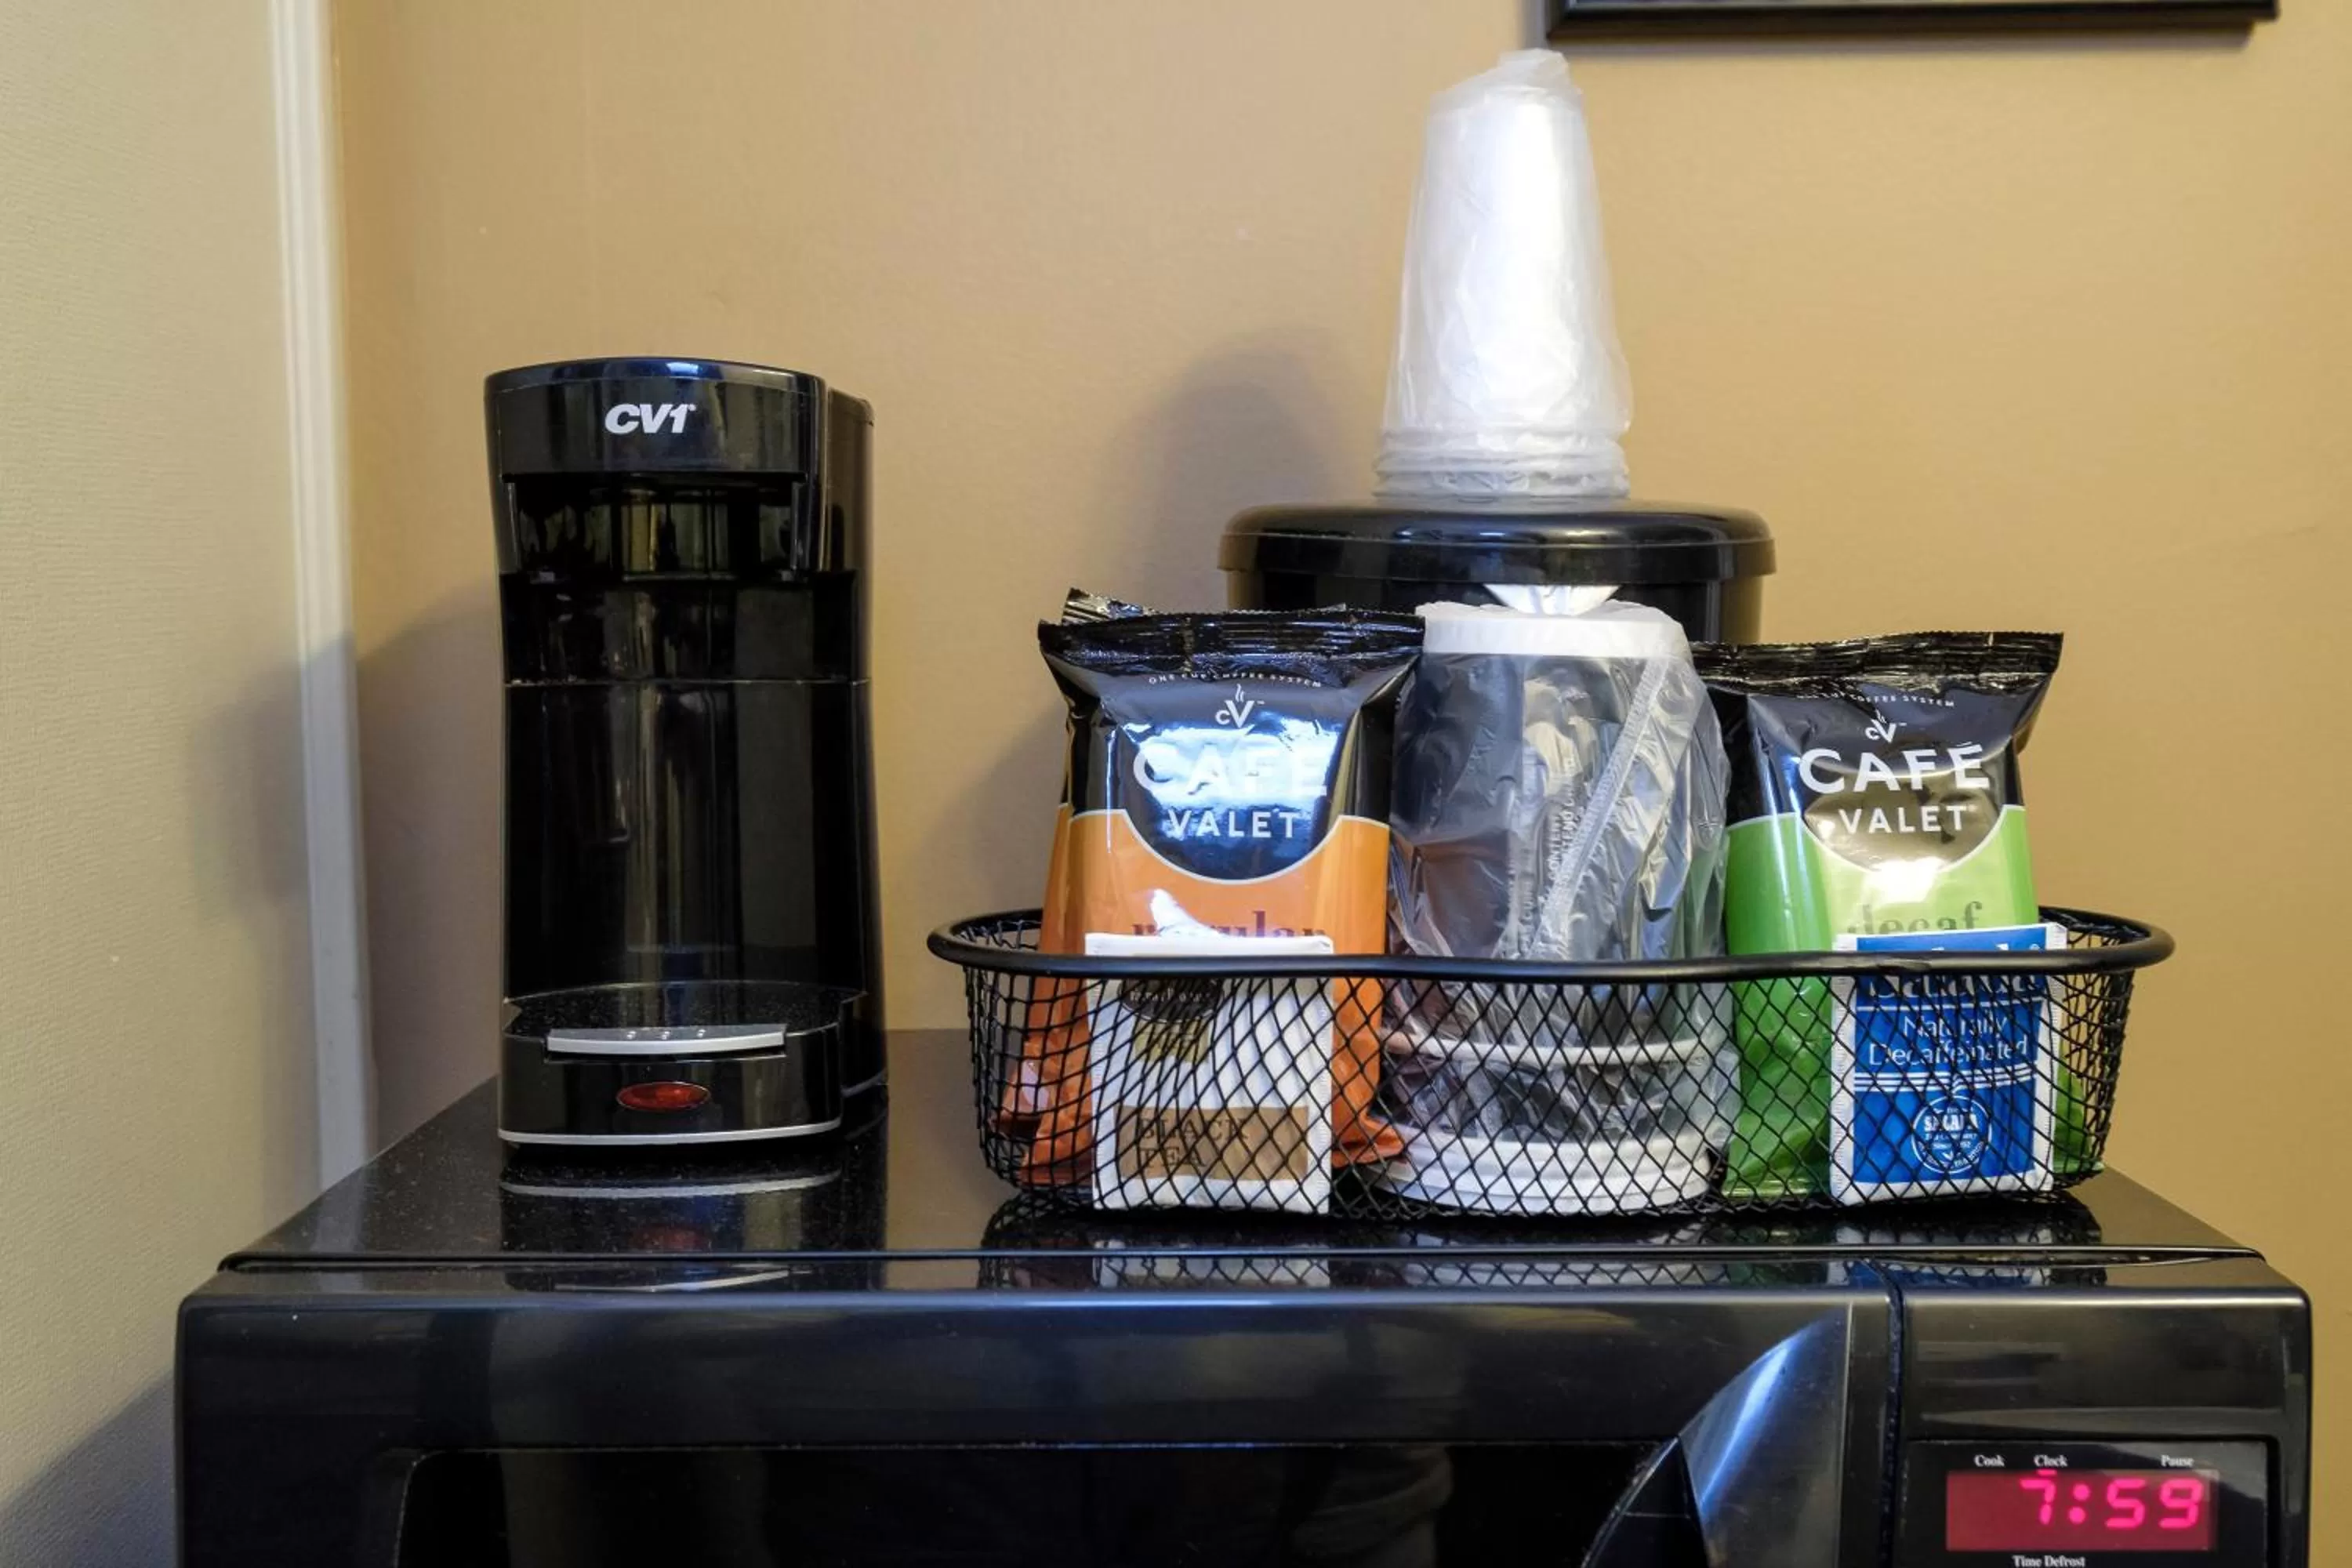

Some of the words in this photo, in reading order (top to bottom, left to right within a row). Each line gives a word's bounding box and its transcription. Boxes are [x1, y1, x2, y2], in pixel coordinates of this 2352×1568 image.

[1167, 809, 1298, 839] VALET
[1838, 805, 1967, 834] VALET
[1974, 1455, 2005, 1467] Cook
[2034, 1455, 2068, 1467] Clock
[2161, 1455, 2194, 1467] Pause
[2020, 1478, 2204, 1529] 7:59
[2012, 1555, 2042, 1567] Time
[2044, 1555, 2085, 1567] Defrost
